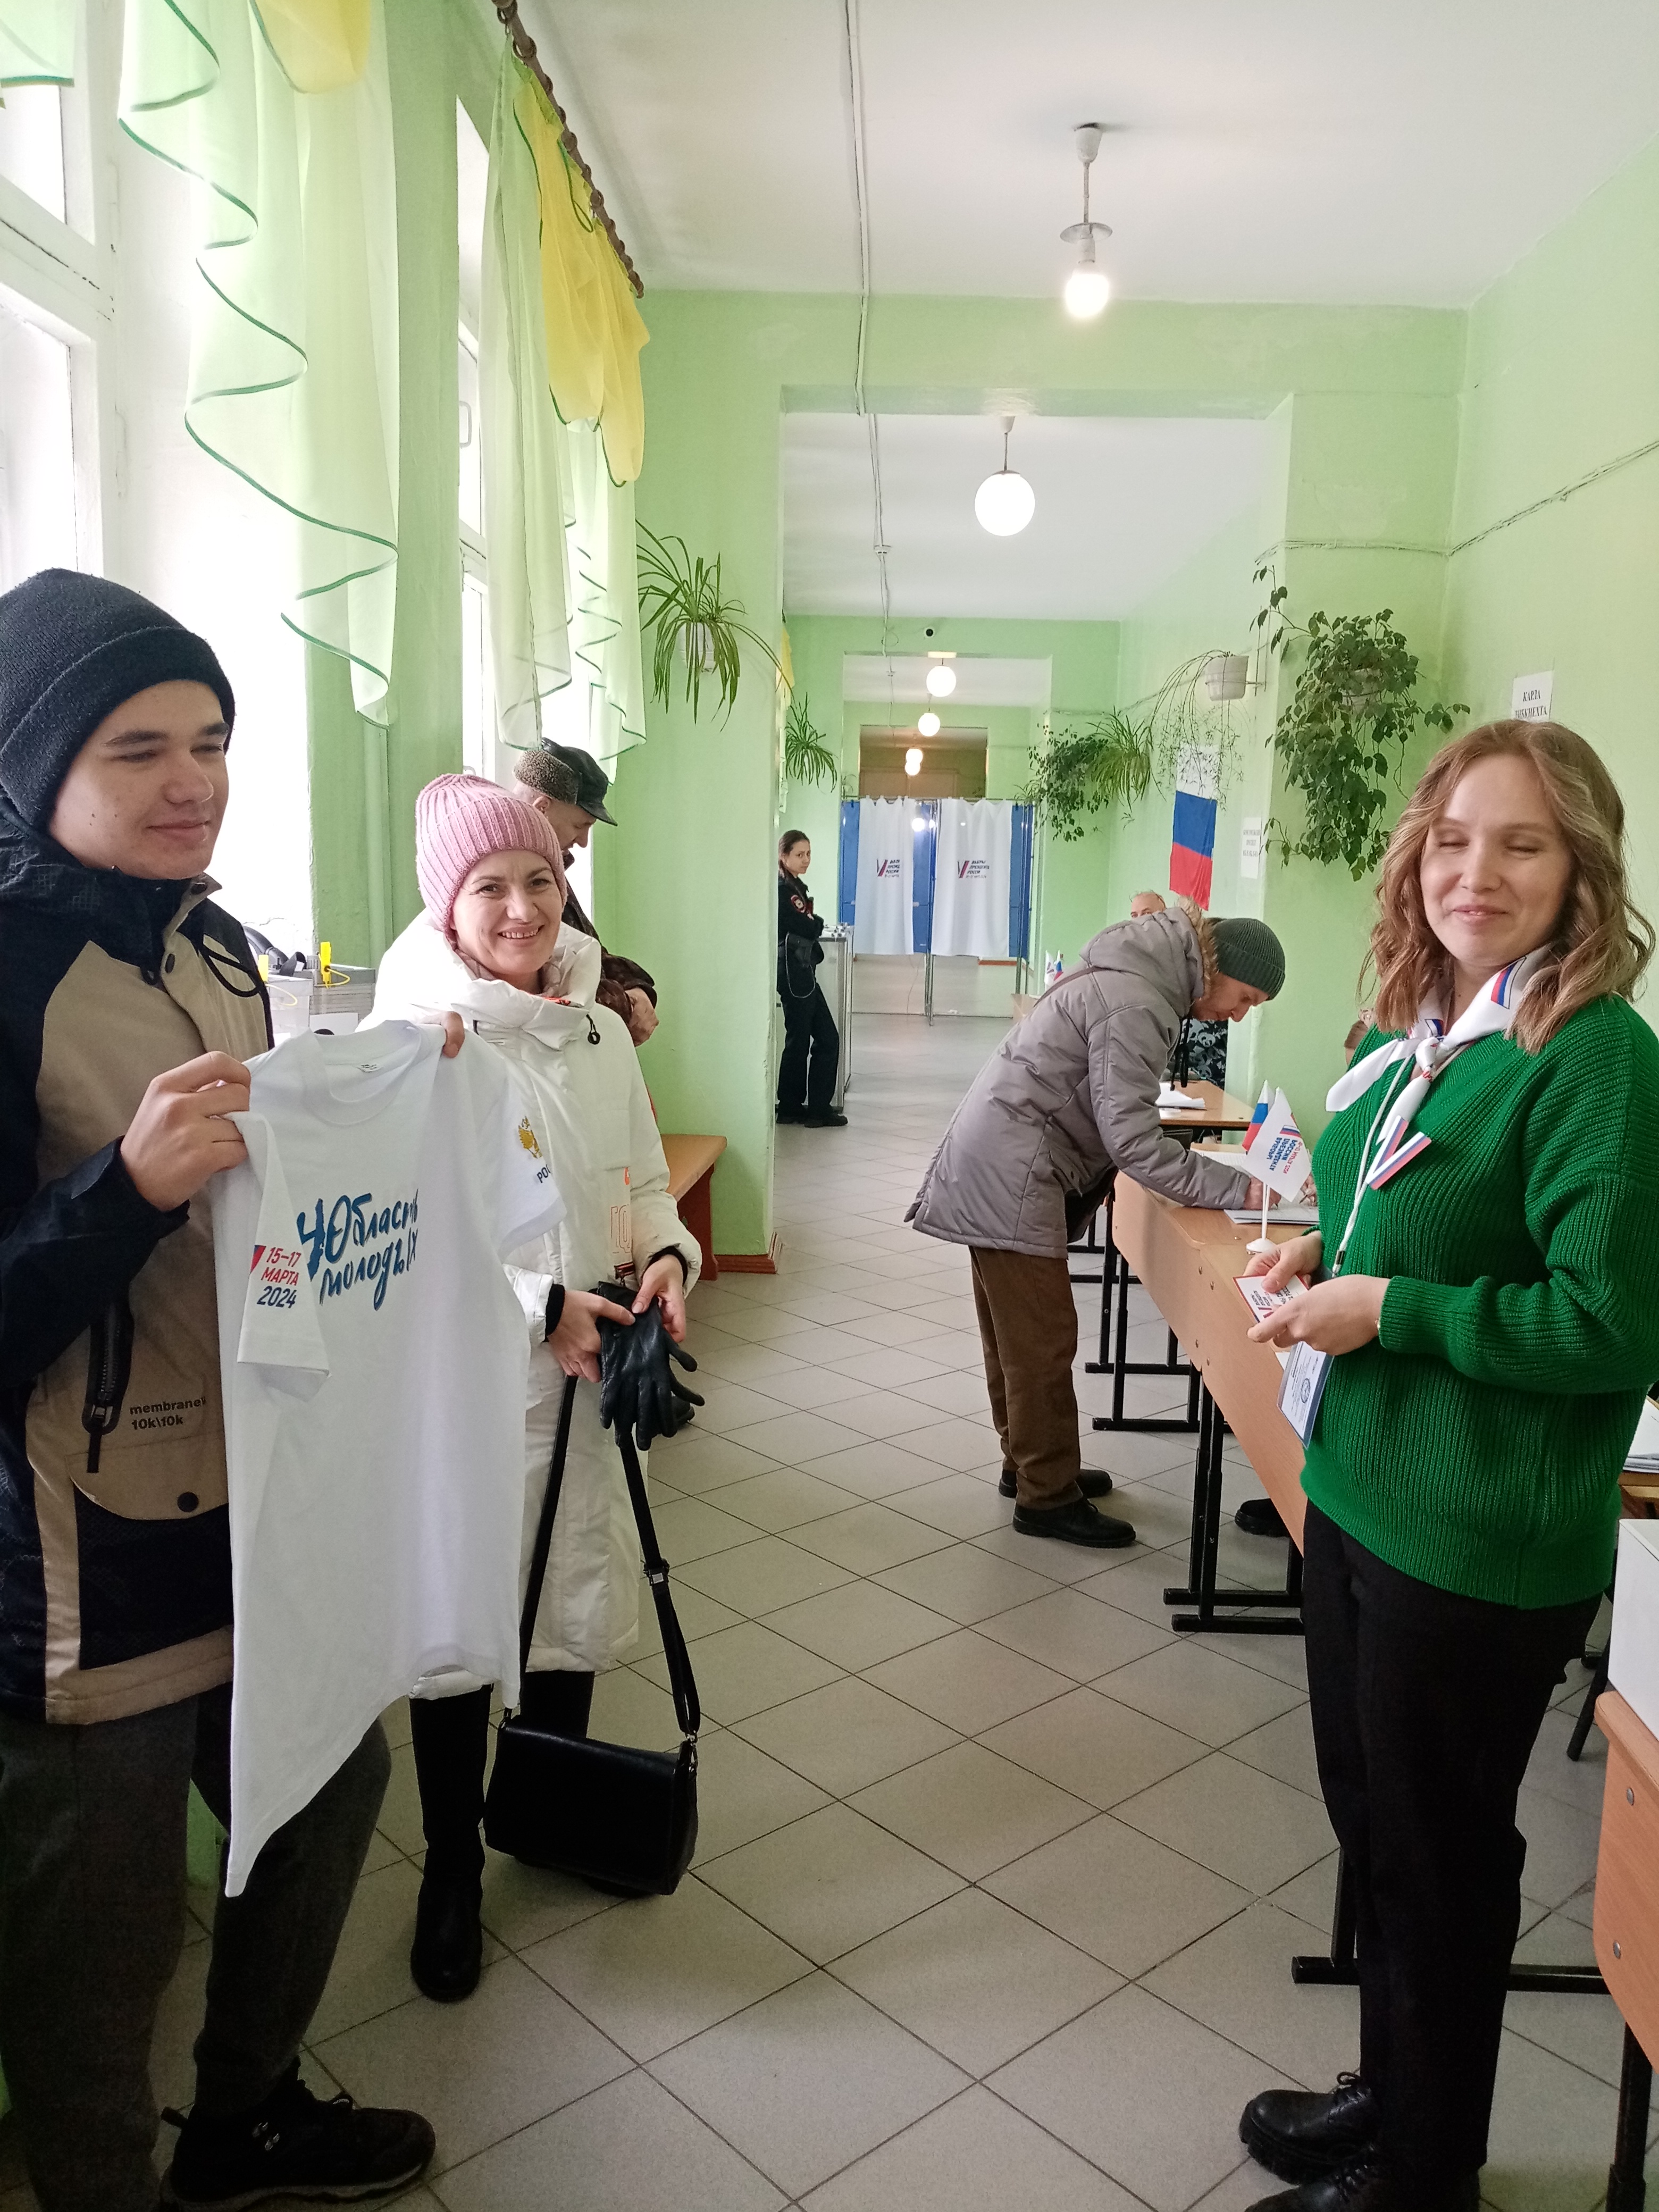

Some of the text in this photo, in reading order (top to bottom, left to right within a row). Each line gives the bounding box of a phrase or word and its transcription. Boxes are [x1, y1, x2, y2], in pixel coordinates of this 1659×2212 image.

[266, 1247, 301, 1267] 15-17
[261, 1267, 299, 1286] МАРТА
[256, 1285, 297, 1309] 2024
